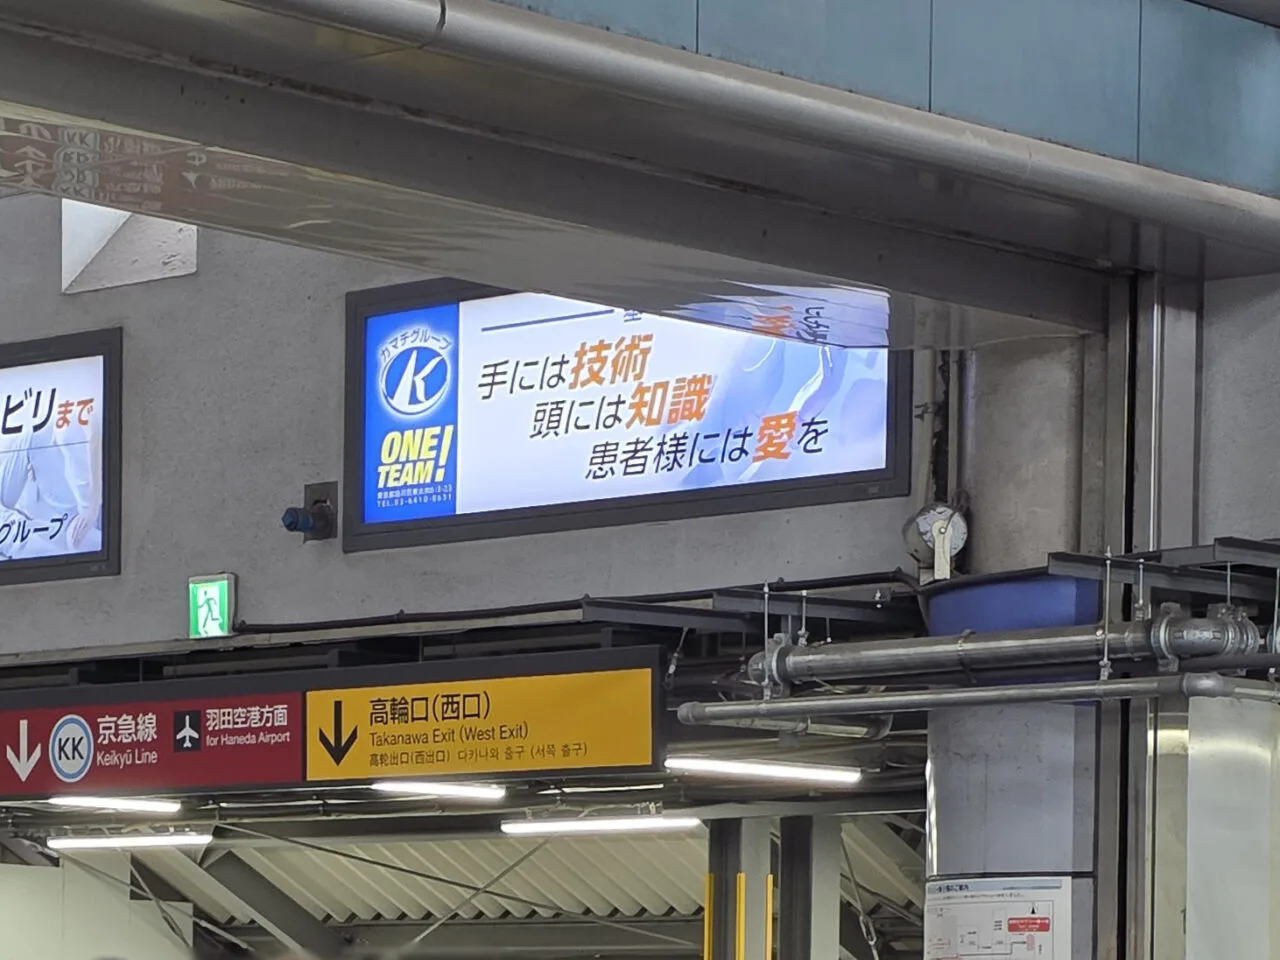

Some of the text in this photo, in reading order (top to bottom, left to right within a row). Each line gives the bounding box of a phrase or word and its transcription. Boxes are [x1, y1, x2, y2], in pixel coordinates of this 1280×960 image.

[477, 333, 654, 400] 手には技術
[528, 374, 712, 440] 頭には知識
[584, 411, 829, 481] 患者様には愛を
[205, 704, 288, 730] 羽田空港方面
[369, 690, 491, 727] 高輪口(西口)
[96, 713, 158, 744] 京急線
[206, 730, 291, 747] for Haneda Airport
[370, 721, 529, 747] Takanawa Exit (West Exit)
[56, 736, 85, 761] KK
[134, 747, 158, 765] Line
